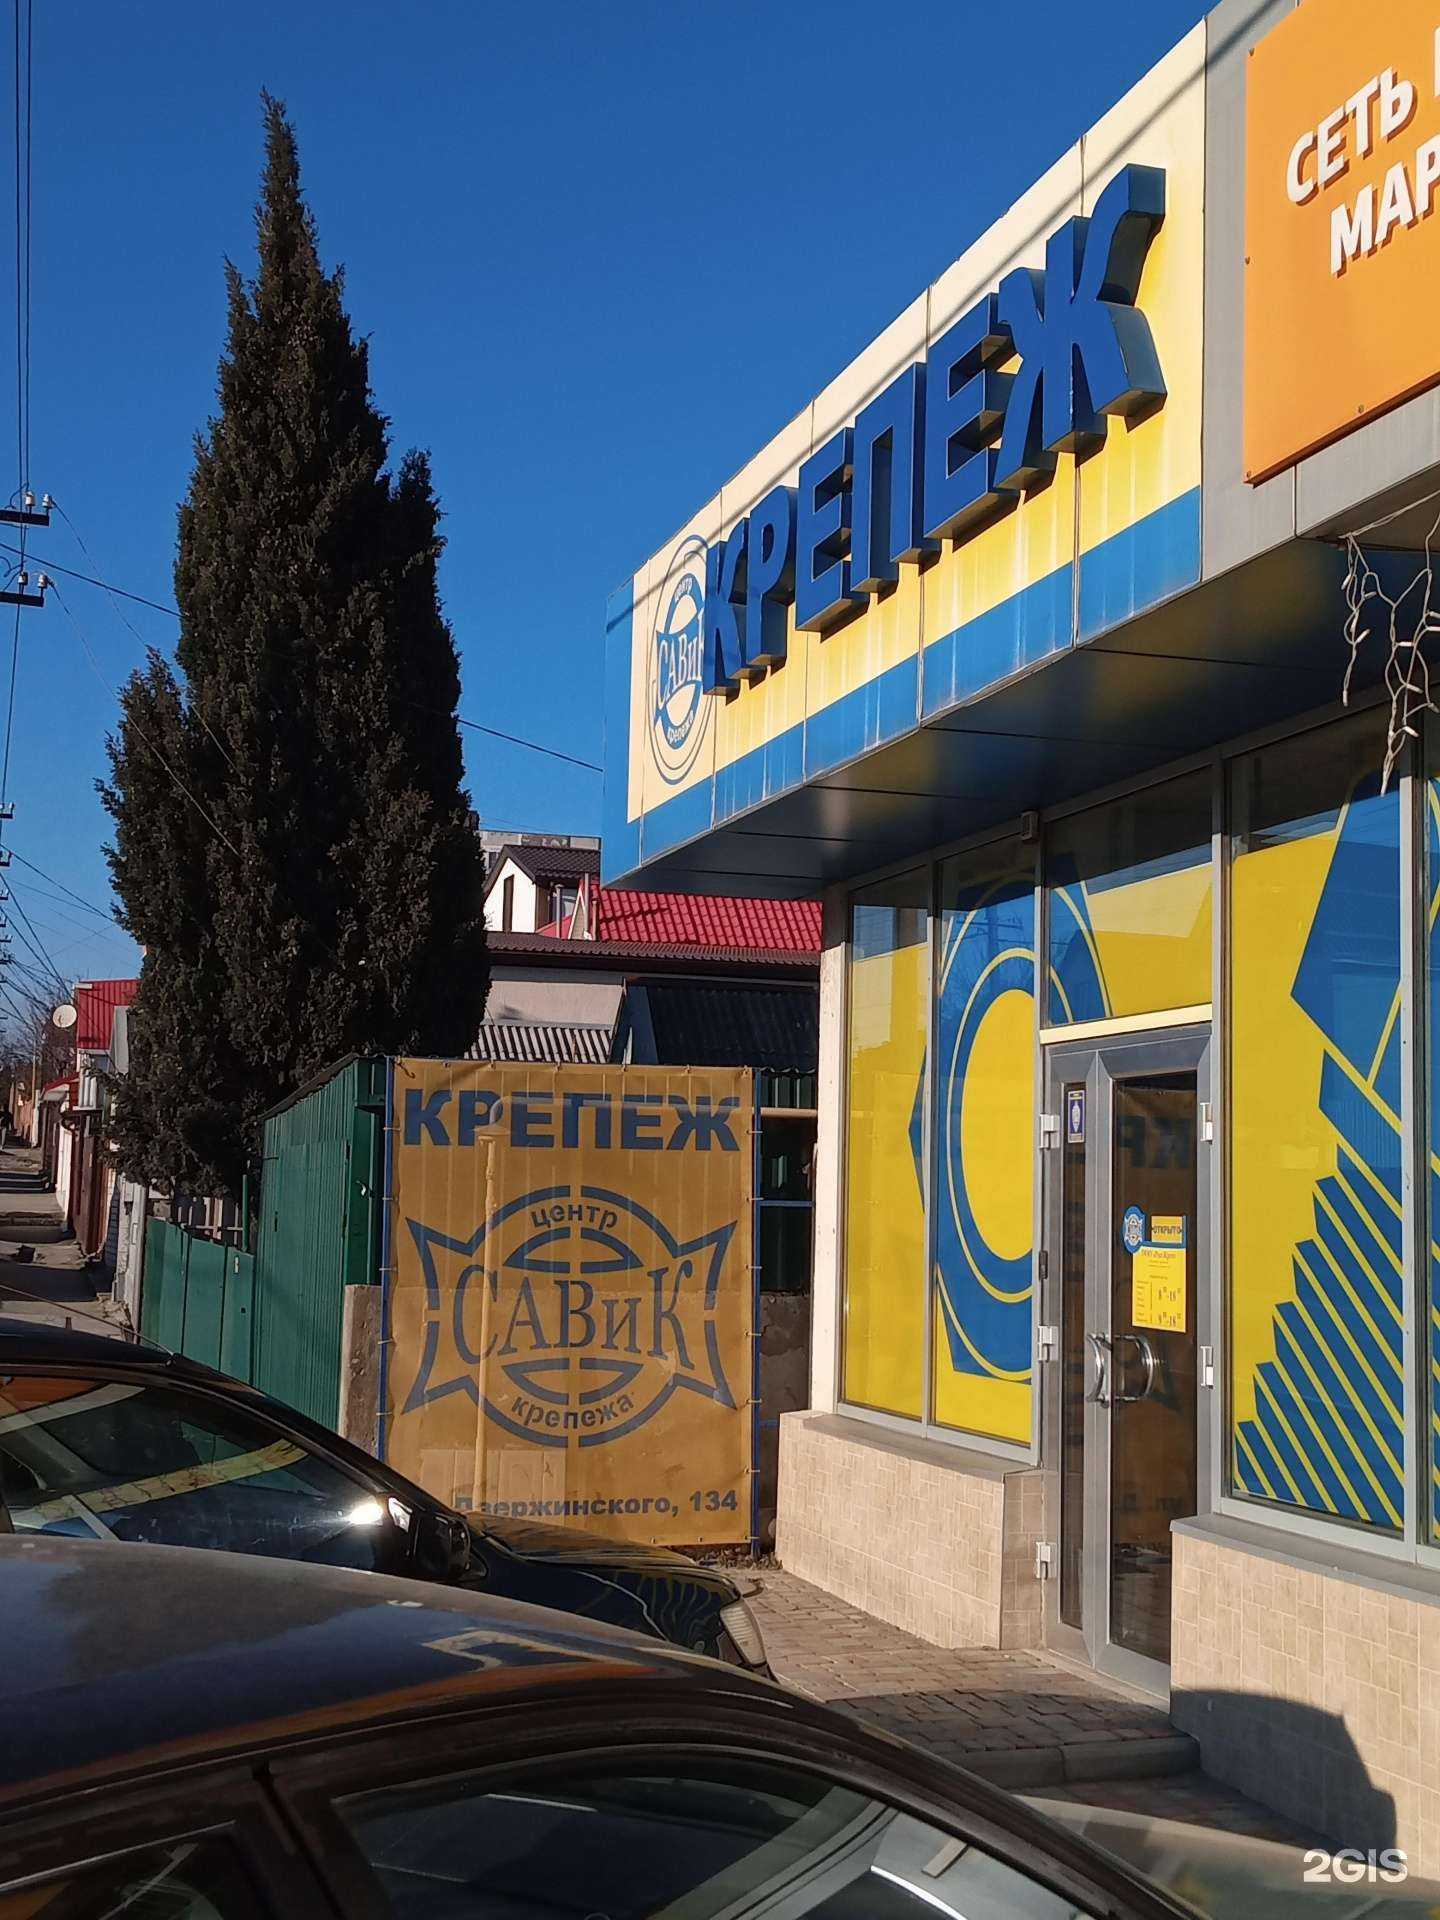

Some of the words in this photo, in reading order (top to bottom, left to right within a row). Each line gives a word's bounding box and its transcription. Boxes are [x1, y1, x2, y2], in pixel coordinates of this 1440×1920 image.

[1287, 67, 1416, 205] СЕТЬ
[703, 163, 1167, 695] КРЕПЕЖ
[403, 1088, 741, 1151] КРЕПЕЖ
[530, 1204, 618, 1231] центр
[511, 1394, 634, 1429] крепежа
[689, 1490, 738, 1512] 134
